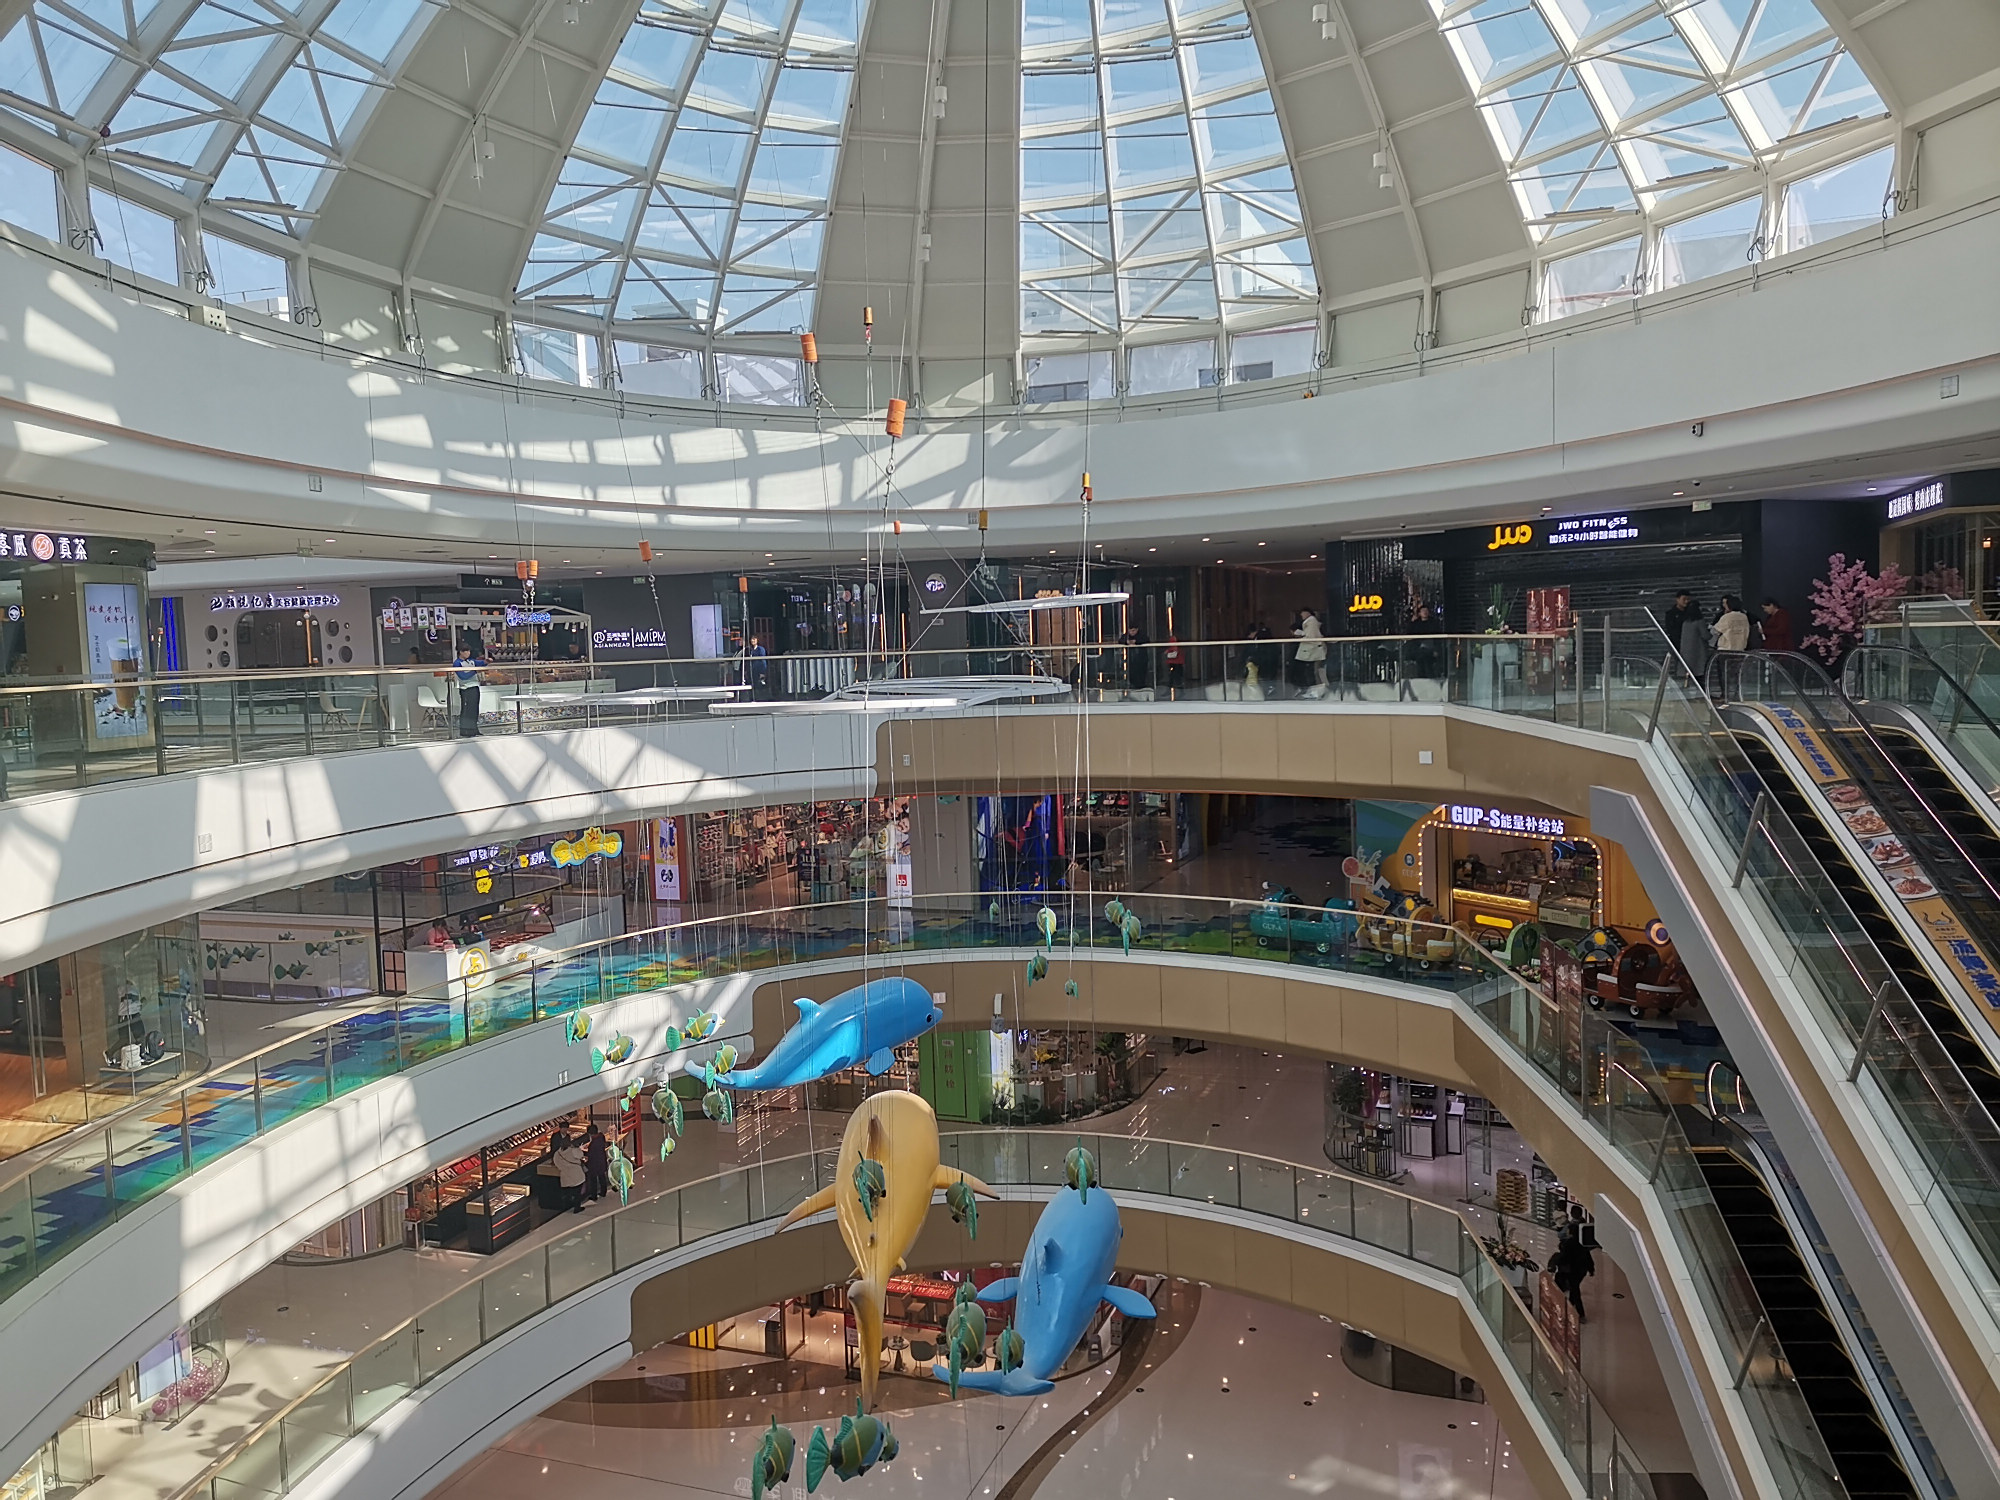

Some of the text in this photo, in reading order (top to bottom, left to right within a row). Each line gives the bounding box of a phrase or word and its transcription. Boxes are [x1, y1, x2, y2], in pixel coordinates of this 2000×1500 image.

[1558, 520, 1580, 531] JWO
[1451, 805, 1565, 835] GUP-S能量补给站
